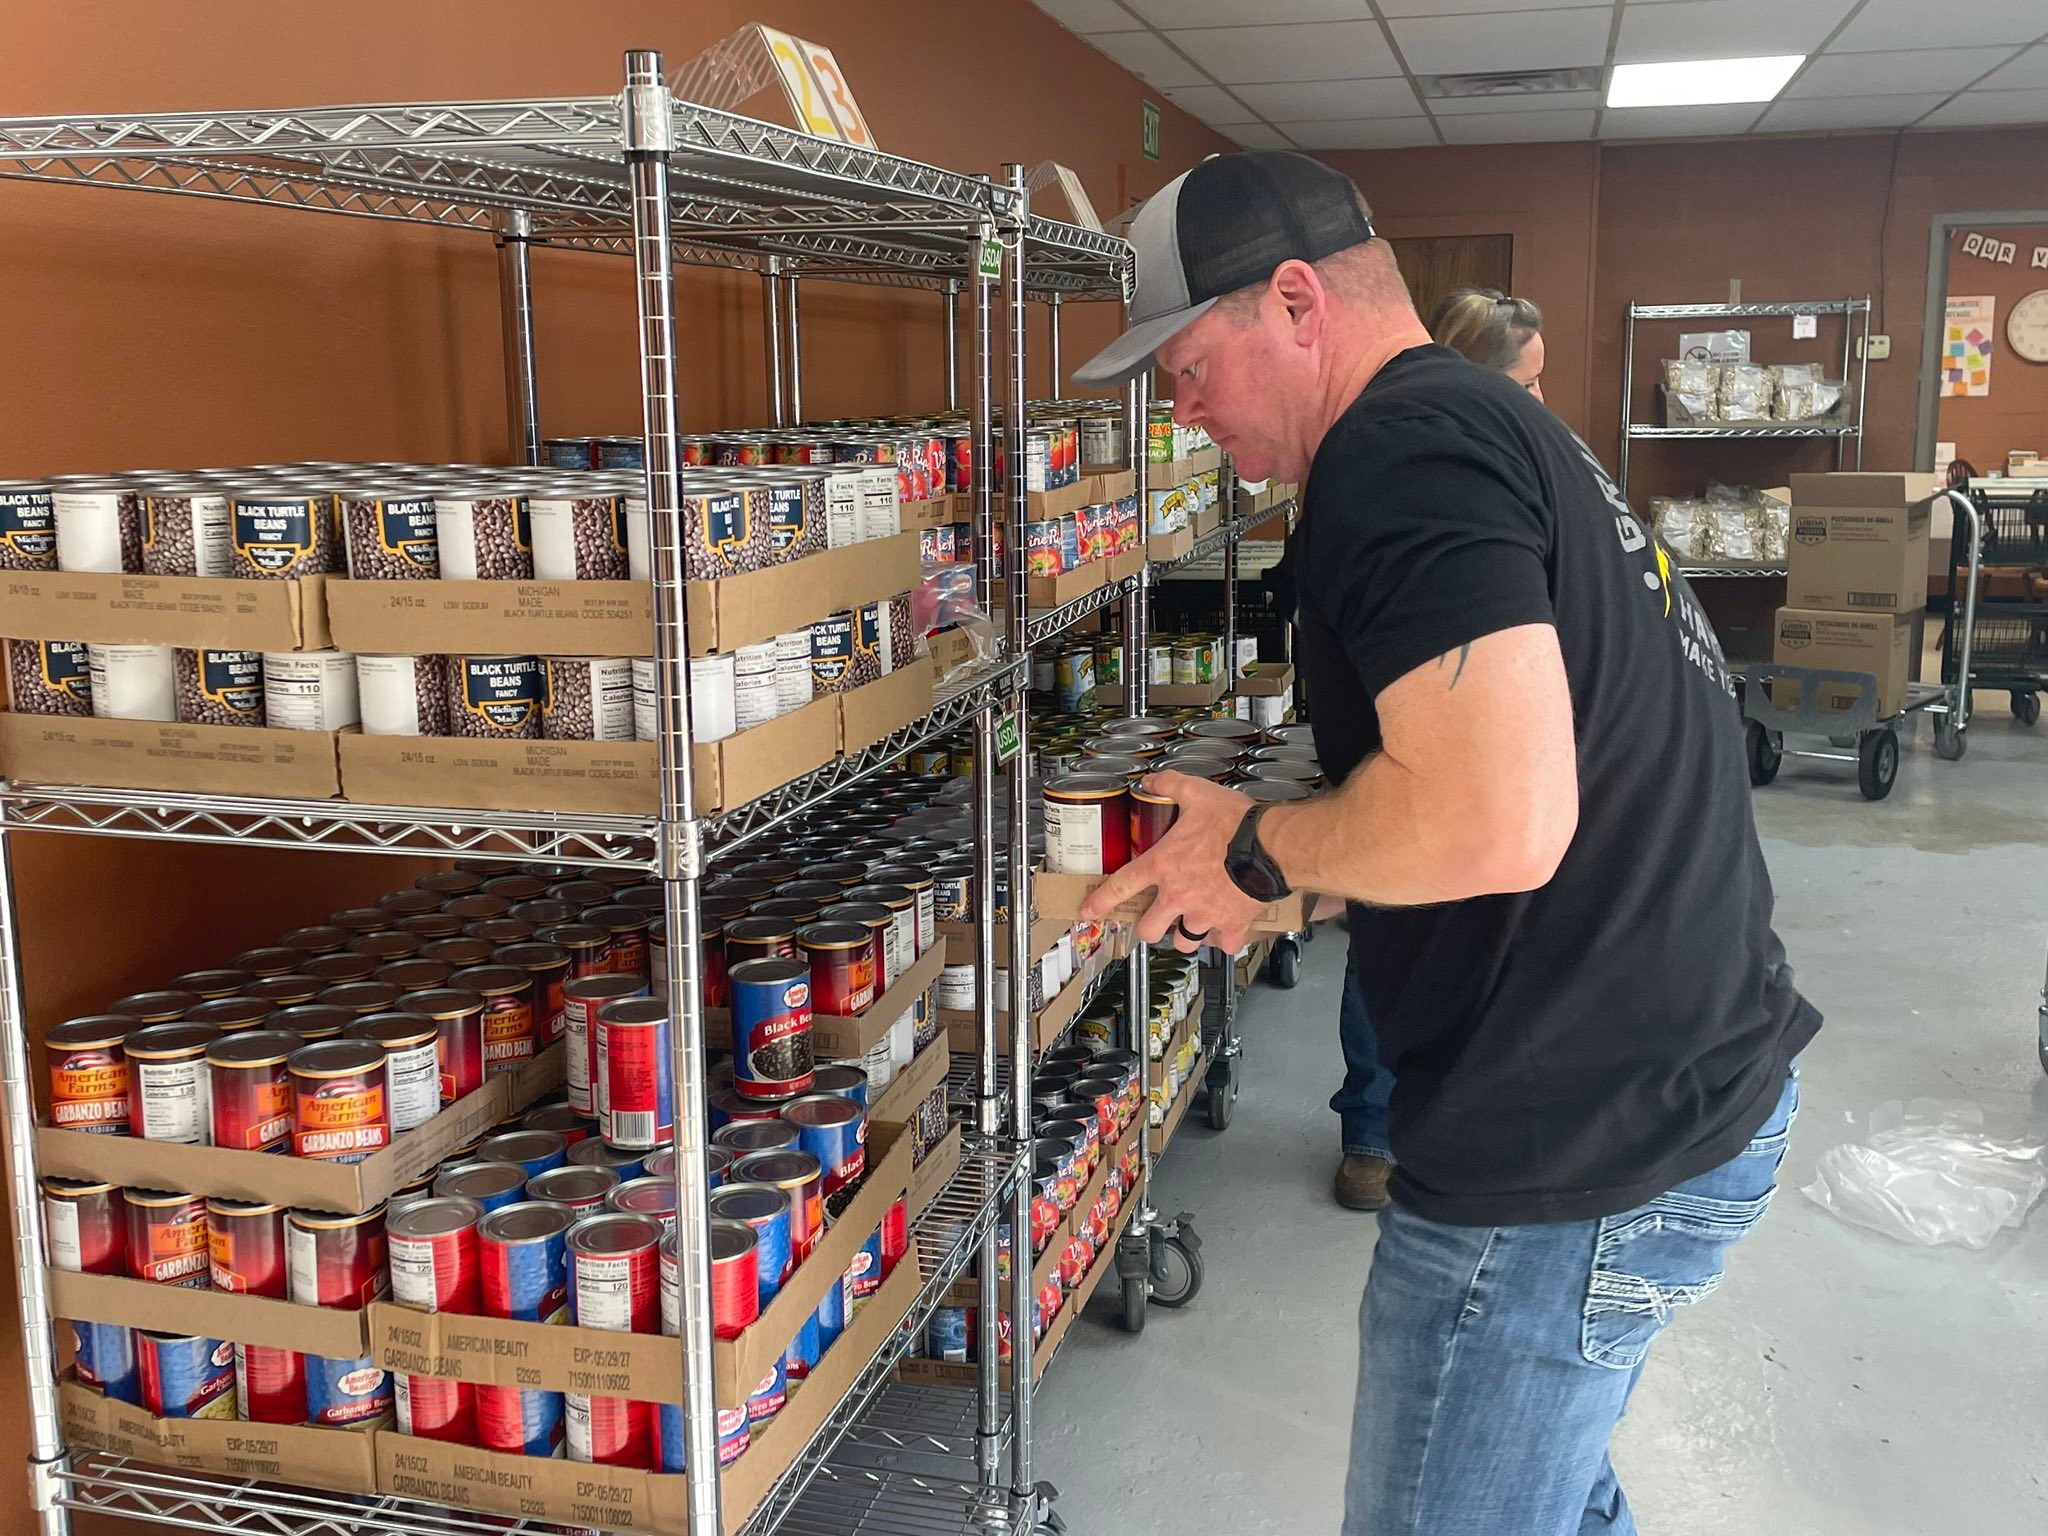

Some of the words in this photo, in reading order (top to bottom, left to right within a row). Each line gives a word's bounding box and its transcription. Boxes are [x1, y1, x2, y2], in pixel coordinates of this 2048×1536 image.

[1968, 237, 2011, 259] OUR
[981, 248, 1000, 269] USDA
[0, 495, 29, 505] BLACK
[31, 494, 50, 504] TUR
[774, 490, 800, 500] TURTLE
[880, 495, 892, 504] 110
[17, 507, 49, 517] BEANS
[237, 505, 267, 517] BLACK
[268, 505, 305, 518] TURTLE
[388, 503, 421, 515] BLACK
[771, 502, 789, 513] EANS
[840, 503, 854, 512] 110
[253, 519, 287, 530] BEANS
[771, 515, 786, 523] ANCY
[258, 532, 282, 541] FANCY
[414, 528, 433, 537] FANCY
[517, 586, 560, 596] MICHIGAN
[519, 597, 543, 607] MADE
[504, 610, 525, 618] BLACK
[528, 610, 554, 618] TURTLE
[556, 610, 578, 618] BEANS
[581, 610, 604, 619] CODE
[811, 625, 826, 635] ACK
[828, 622, 850, 633] TURTLE
[816, 635, 841, 646] BEANS
[208, 652, 238, 663] BLACK
[228, 663, 259, 674] BEANS
[470, 663, 502, 676] BLACK
[503, 662, 536, 674] TURTLE
[490, 676, 522, 688] BEANS
[736, 679, 761, 687] alories
[298, 684, 320, 693] 110
[495, 689, 517, 698] FANCY
[999, 725, 1018, 750] USDA
[526, 746, 567, 756] MICHIGAN
[527, 757, 550, 767] MADE
[513, 767, 534, 776] BLACK
[536, 768, 561, 776] TURTLE
[589, 769, 611, 778] CODE
[613, 770, 639, 779] 504251
[764, 1020, 797, 1037] Black
[799, 1013, 812, 1025] Bea
[484, 1041, 512, 1059] BANZO
[56, 1068, 127, 1084] American
[67, 1080, 117, 1094] Farms
[305, 1095, 376, 1111] American
[55, 1102, 101, 1122] GARBANZO
[320, 1108, 368, 1122] Farms
[302, 1130, 353, 1153] GARBANZO
[356, 1128, 382, 1147] BEANS
[839, 1156, 864, 1178] Black
[155, 1251, 209, 1281] GARBANZO
[612, 1282, 628, 1290] 120
[447, 1334, 493, 1354] AMERICAN
[495, 1339, 529, 1357] BEAUTY
[384, 1347, 431, 1376] GARBANZO
[327, 1402, 372, 1418] Garbanzo
[453, 1464, 497, 1484] AMERICAN
[498, 1472, 532, 1490] BEAUTY
[393, 1474, 439, 1498] GARBANZO
[440, 1483, 470, 1504] BEANS
